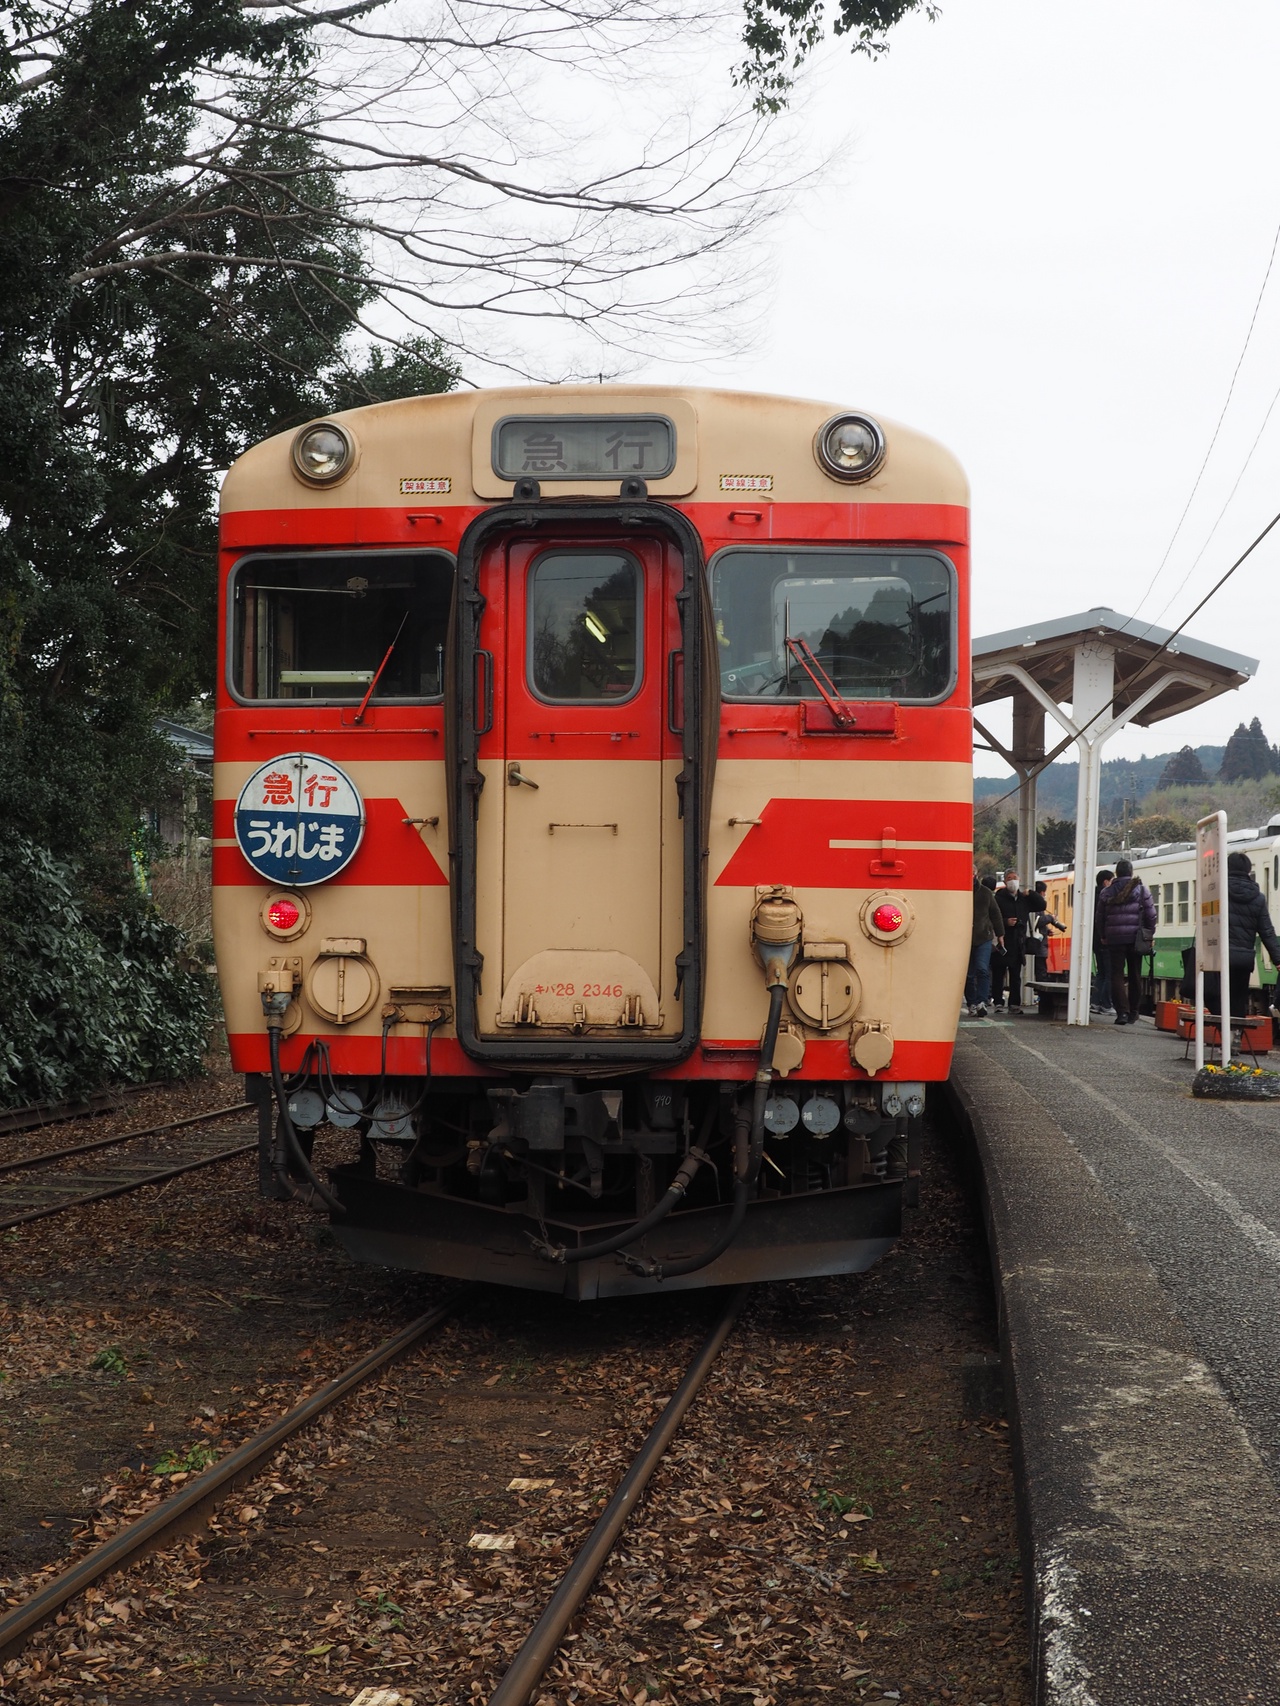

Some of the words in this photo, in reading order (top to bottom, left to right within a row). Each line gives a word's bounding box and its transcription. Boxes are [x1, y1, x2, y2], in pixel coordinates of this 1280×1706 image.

[521, 431, 653, 471] 急行
[405, 481, 446, 491] 架線注意
[725, 478, 768, 488] 架線注意
[262, 771, 338, 808] 急行
[247, 820, 345, 861] うわじま
[535, 983, 575, 997] キハ28
[582, 983, 623, 998] 2346
